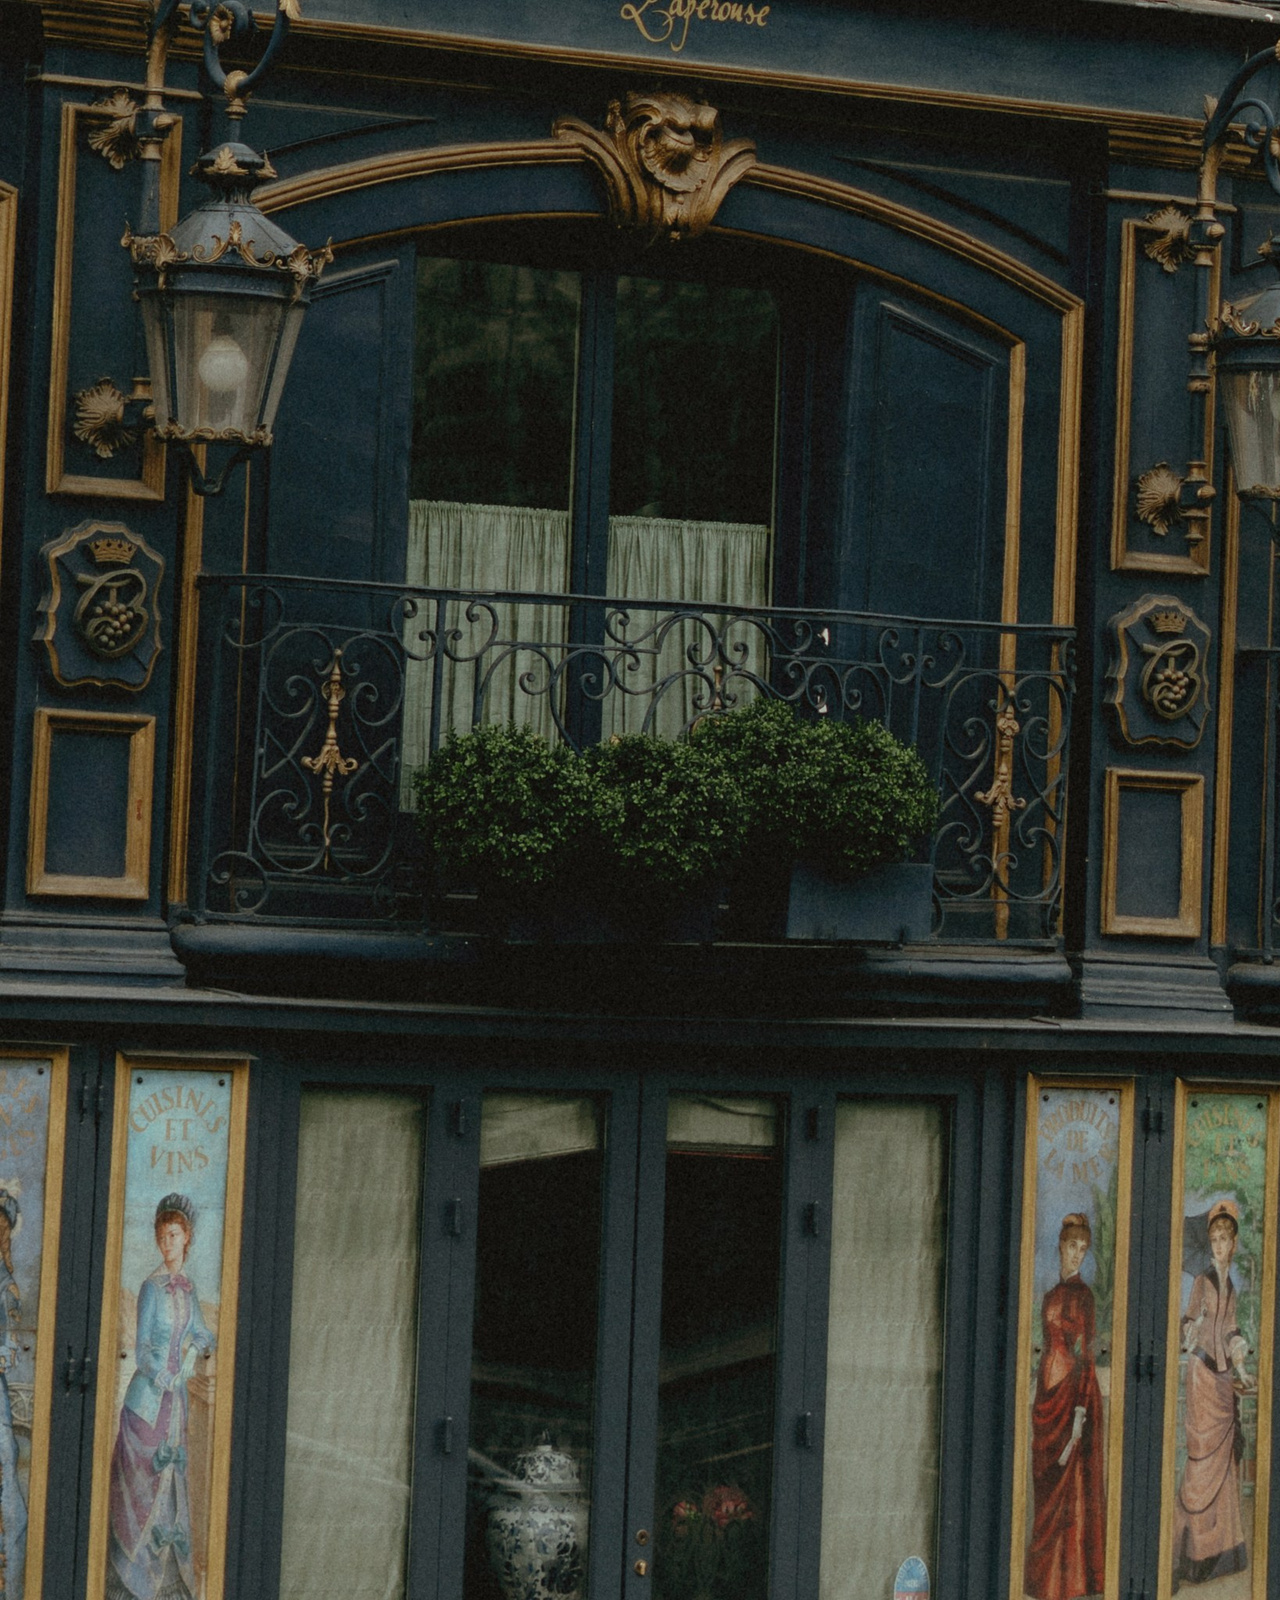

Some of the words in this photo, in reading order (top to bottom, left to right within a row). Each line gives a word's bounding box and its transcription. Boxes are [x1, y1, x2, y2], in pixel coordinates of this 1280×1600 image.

[129, 1085, 227, 1134] CUISINES
[164, 1118, 196, 1142] ET
[1066, 1129, 1089, 1154] DE
[150, 1144, 211, 1176] VINS
